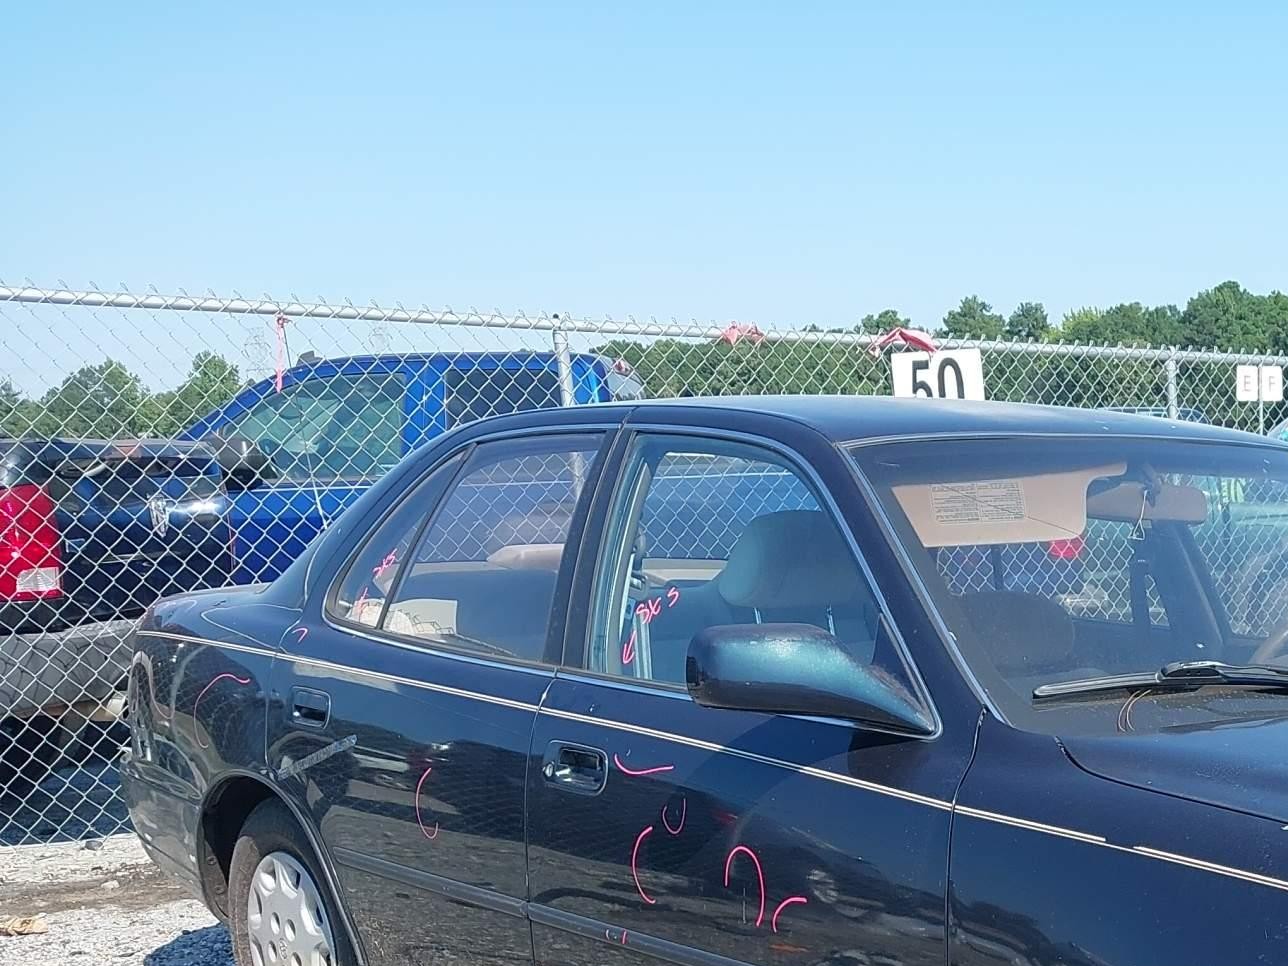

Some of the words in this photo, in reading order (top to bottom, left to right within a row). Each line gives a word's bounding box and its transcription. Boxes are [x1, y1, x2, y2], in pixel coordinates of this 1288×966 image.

[911, 357, 965, 400] 50
[1243, 375, 1252, 392] E
[1268, 375, 1276, 392] F
